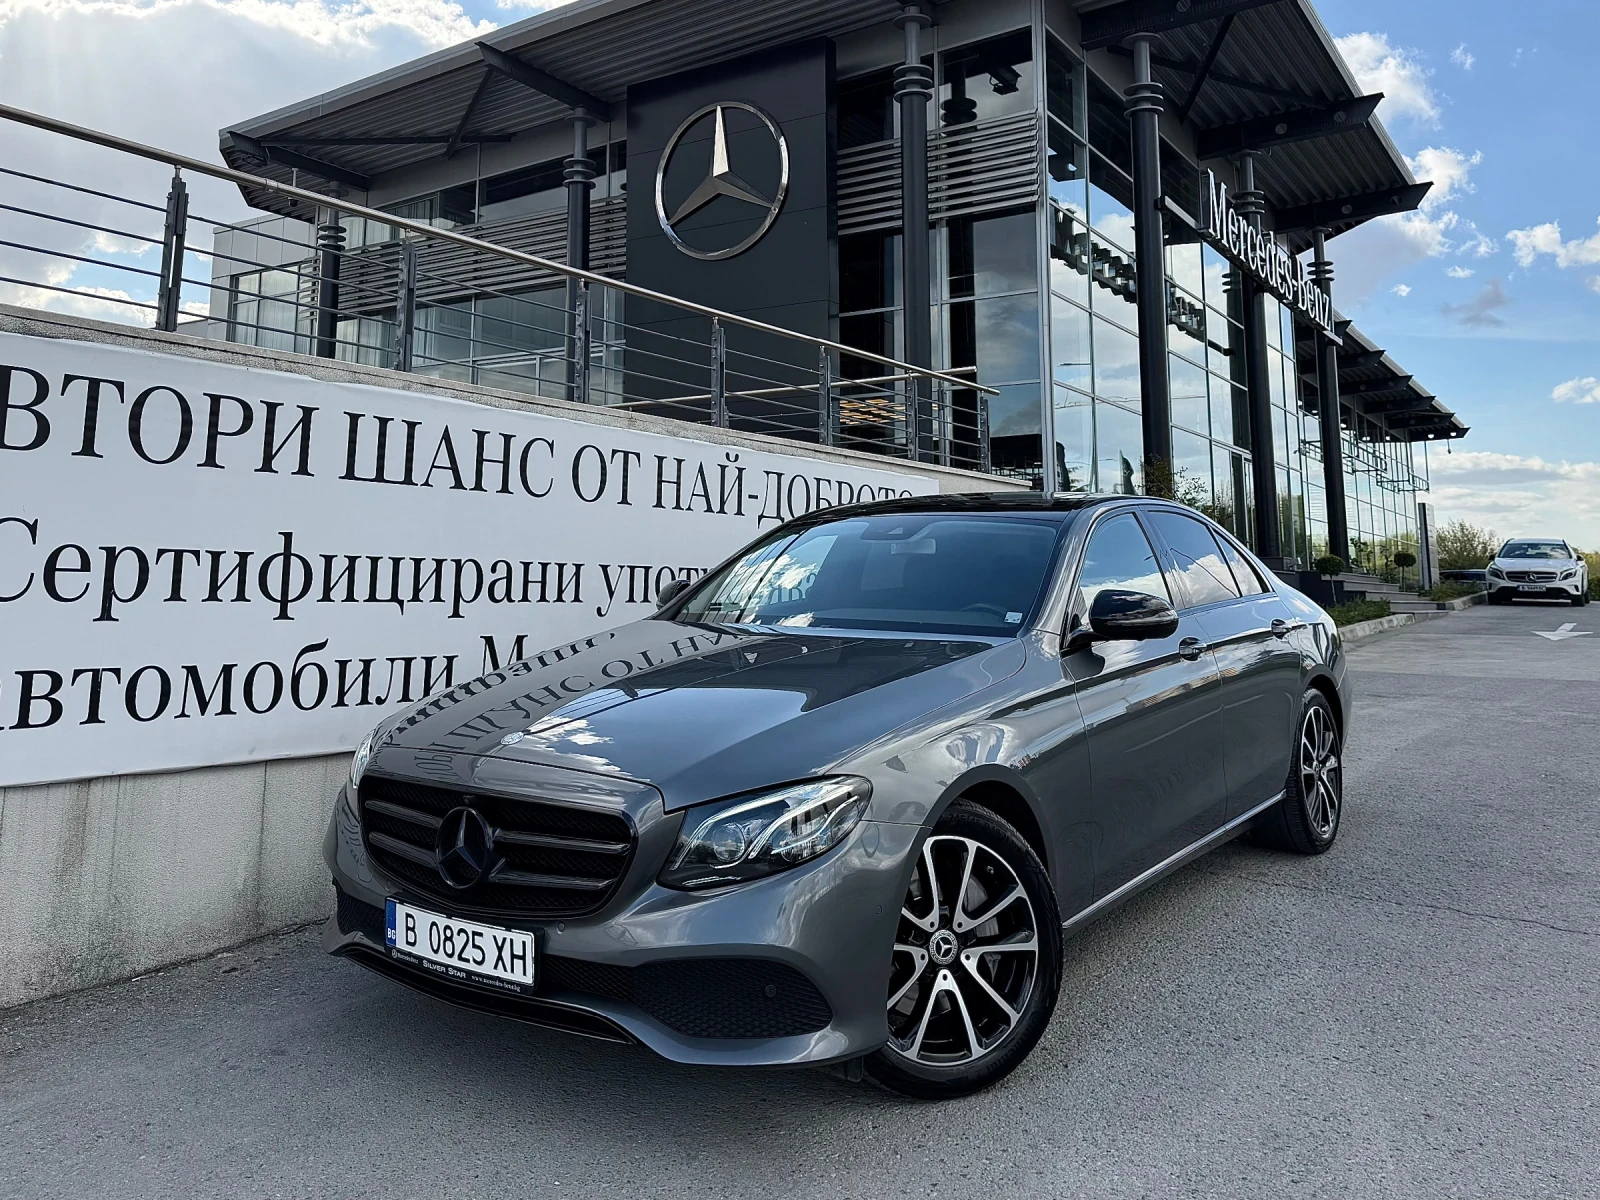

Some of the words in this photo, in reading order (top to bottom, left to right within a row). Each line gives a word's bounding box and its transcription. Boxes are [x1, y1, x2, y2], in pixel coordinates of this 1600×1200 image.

[1207, 167, 1332, 331] Mercedes-Benz
[0, 364, 320, 478] ВТОРИ
[338, 410, 556, 498] ШАНС
[571, 444, 641, 504] ОТ
[651, 451, 915, 530] НАЙ-ДОБР
[0, 516, 585, 623] Сертифицирани
[0, 638, 459, 731] втомобили
[387, 928, 396, 939] BG
[404, 911, 417, 947] B
[429, 920, 486, 966] 0825
[492, 934, 528, 977] XH
[422, 959, 446, 973] SILVER
[447, 967, 467, 979] STAR
